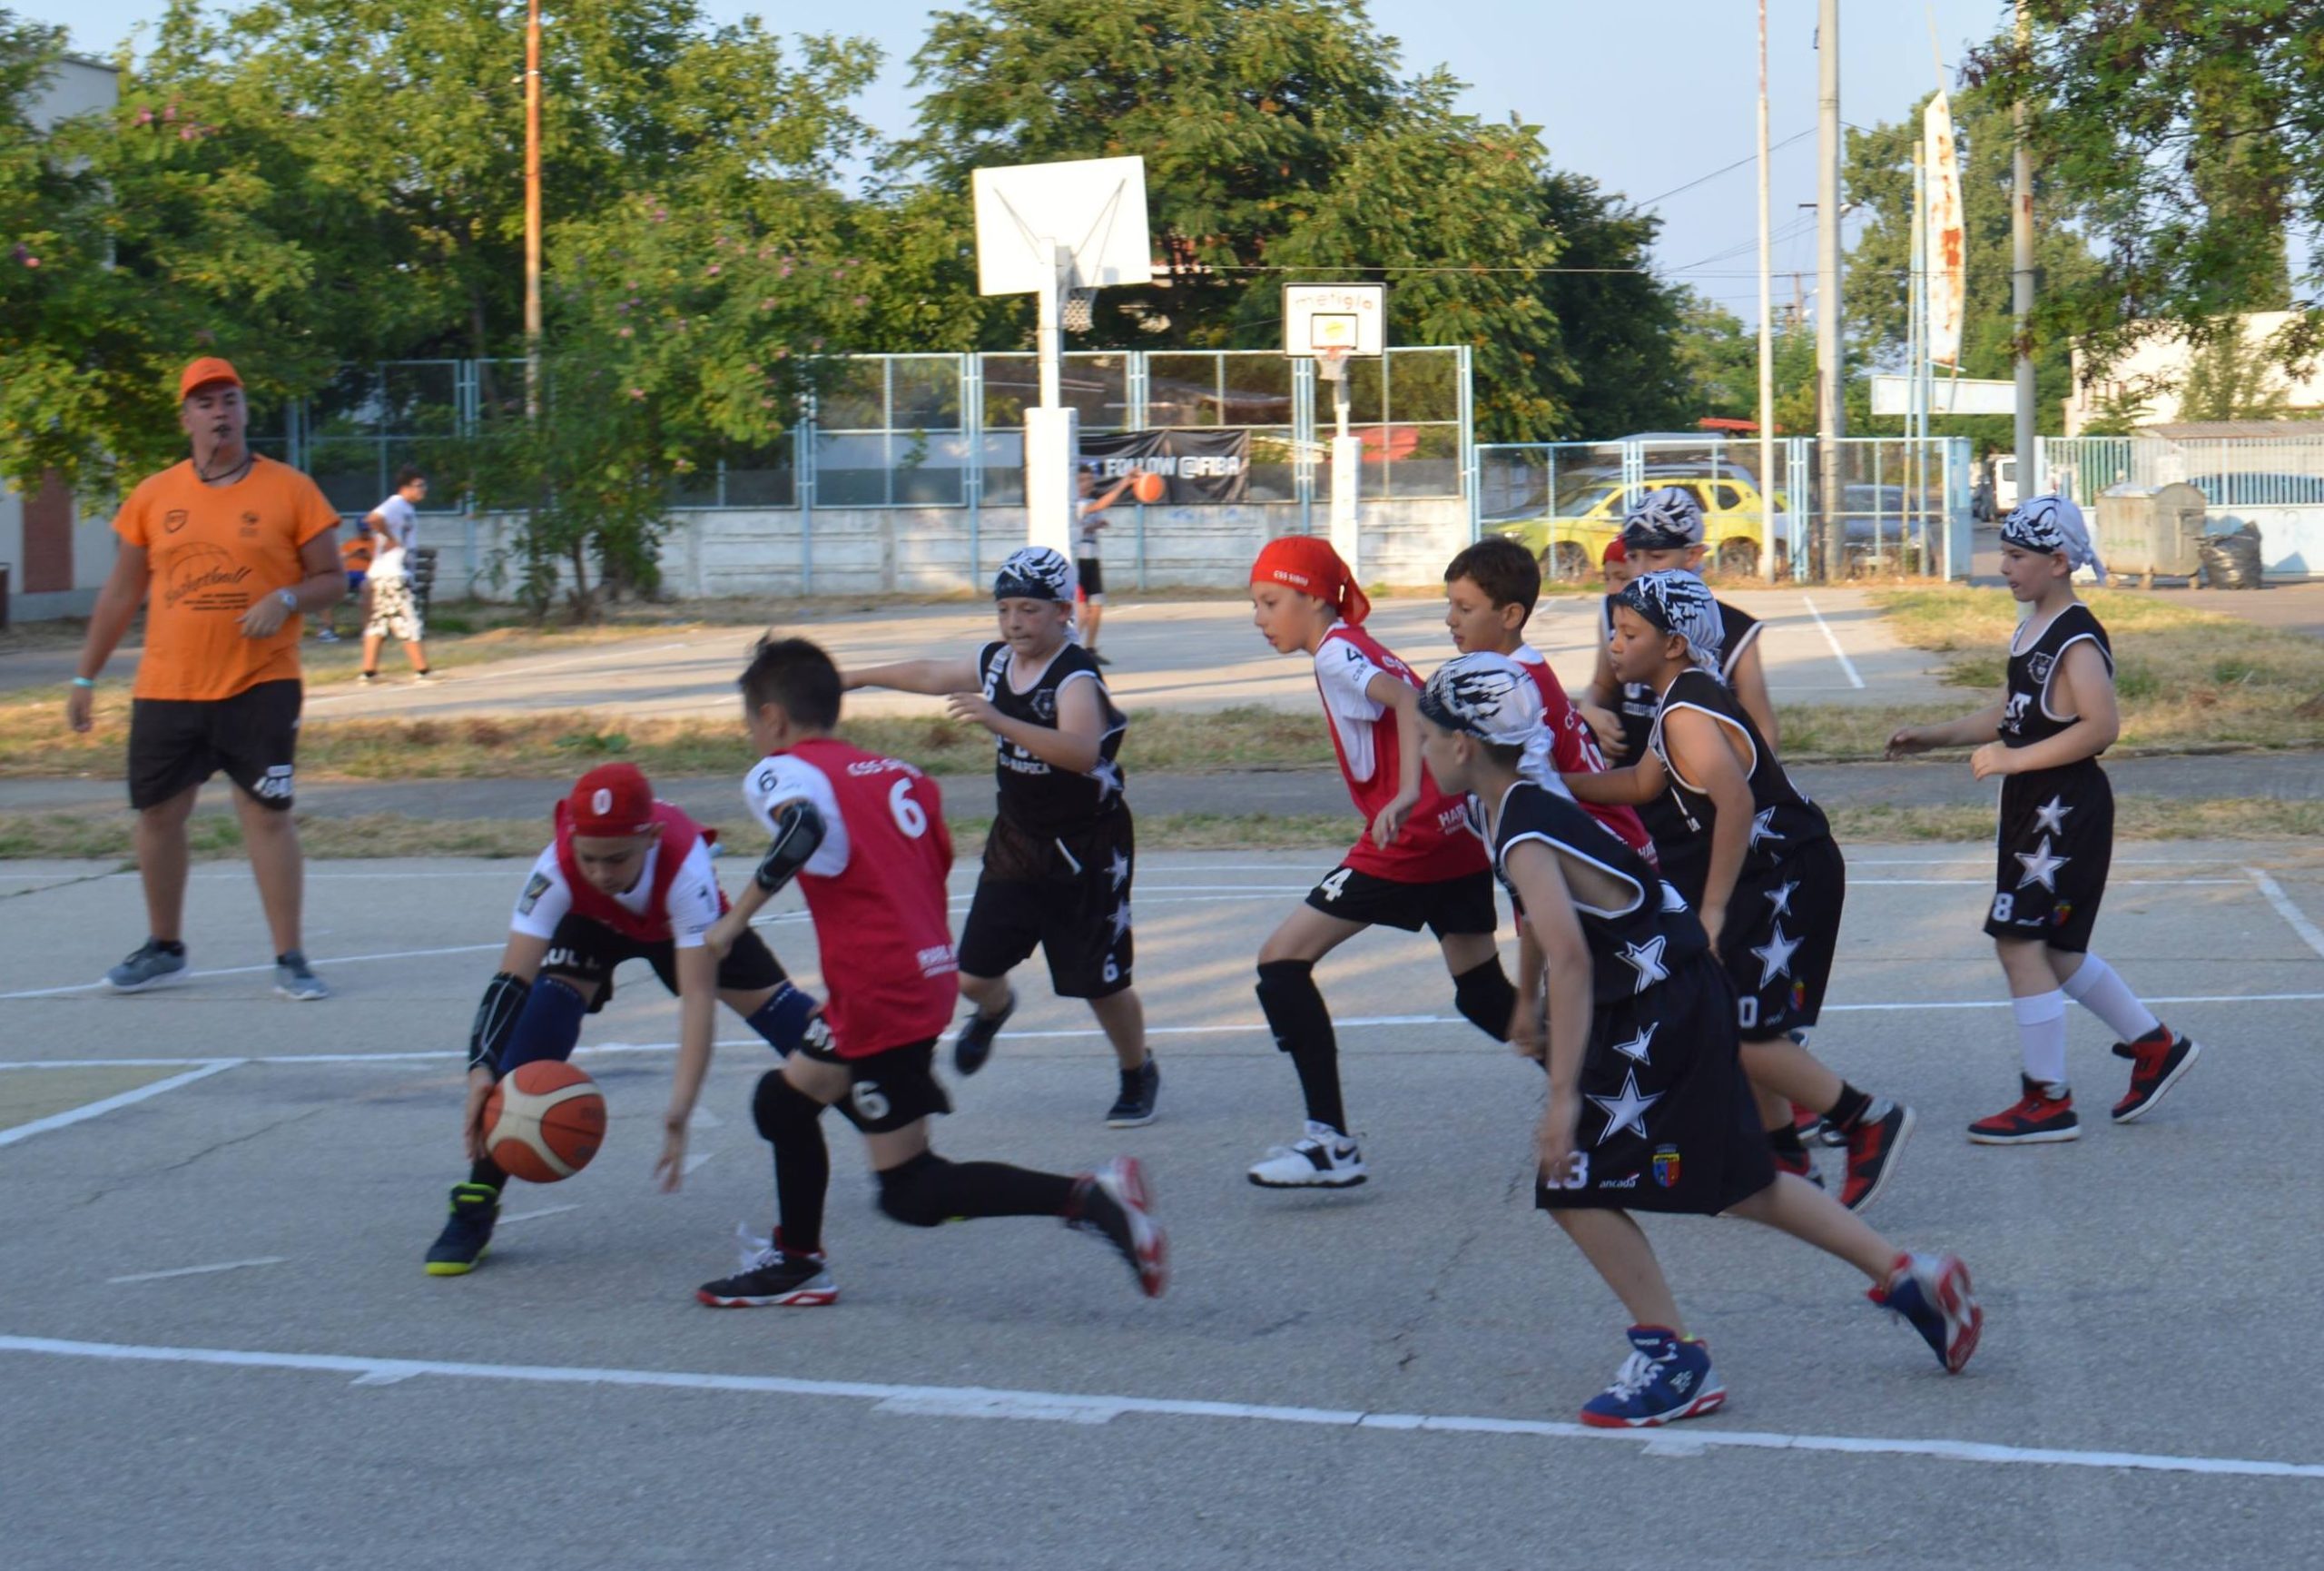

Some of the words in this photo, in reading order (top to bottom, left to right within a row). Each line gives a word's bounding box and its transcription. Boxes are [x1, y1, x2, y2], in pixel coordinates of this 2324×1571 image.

[758, 768, 778, 792] 6
[592, 787, 613, 816] 0
[889, 777, 928, 839] 6
[1320, 867, 1354, 902] 4
[1992, 893, 2014, 923] 8
[1102, 953, 1119, 983] 6
[852, 1080, 891, 1121] 6
